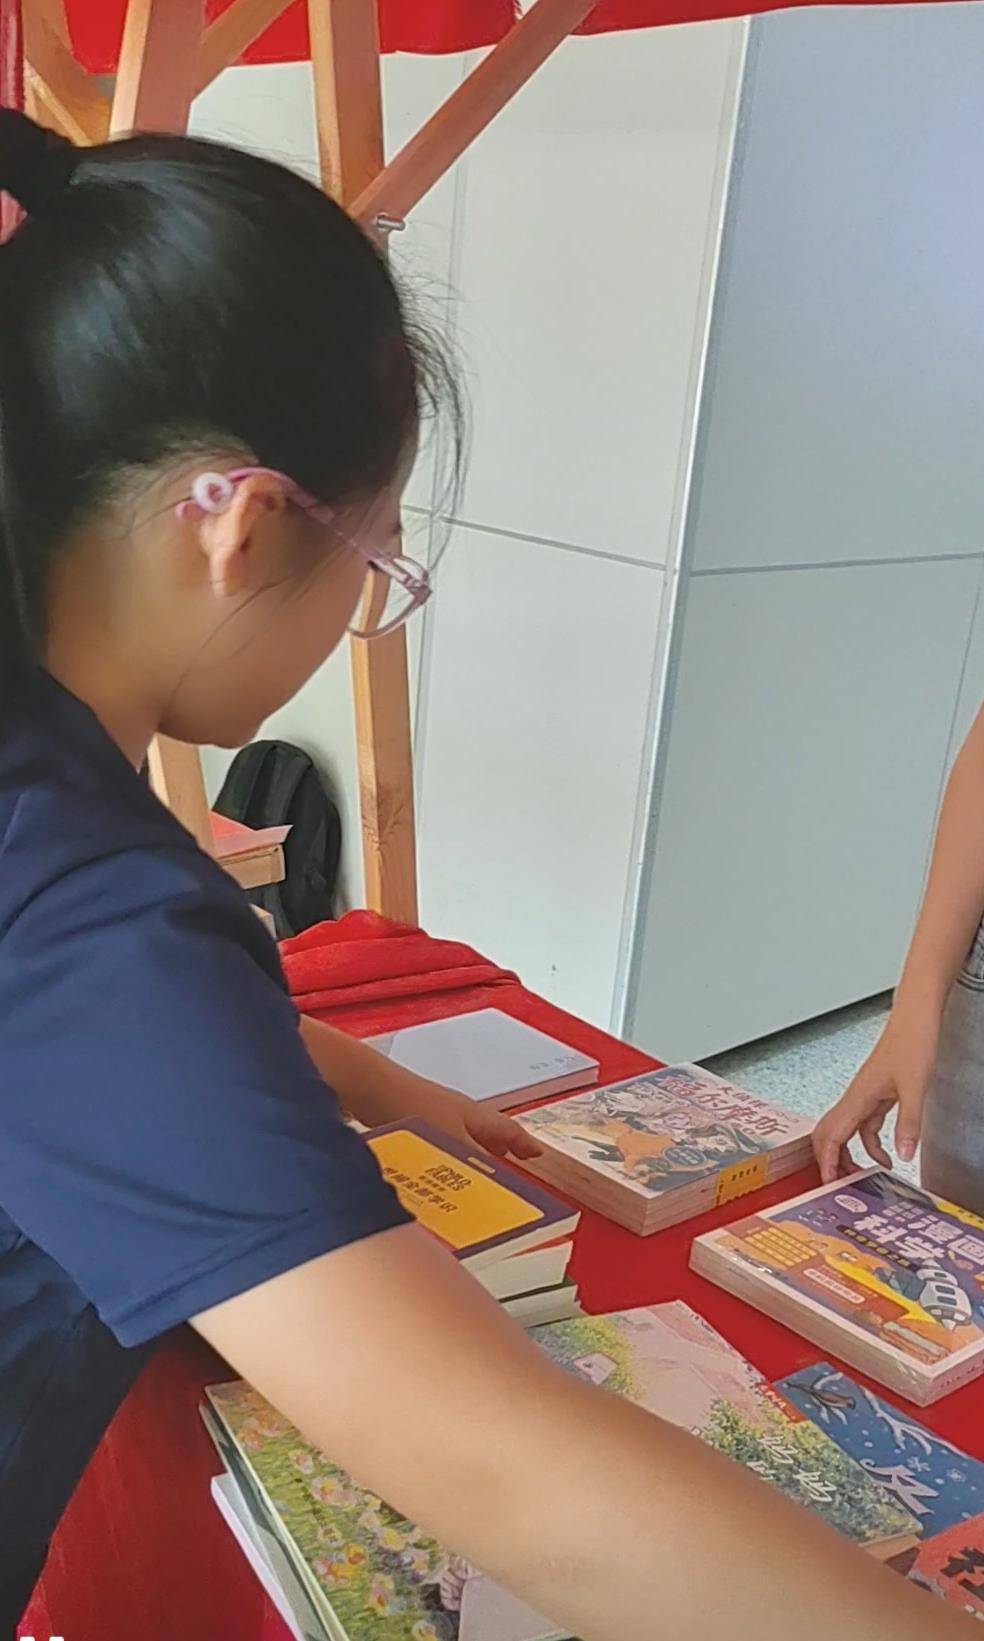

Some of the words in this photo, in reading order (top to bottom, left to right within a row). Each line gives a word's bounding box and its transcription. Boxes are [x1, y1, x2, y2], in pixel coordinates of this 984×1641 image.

[657, 1076, 790, 1136] 福尔摩斯
[852, 1213, 945, 1260] 科学
[756, 1434, 837, 1502] 妈妈
